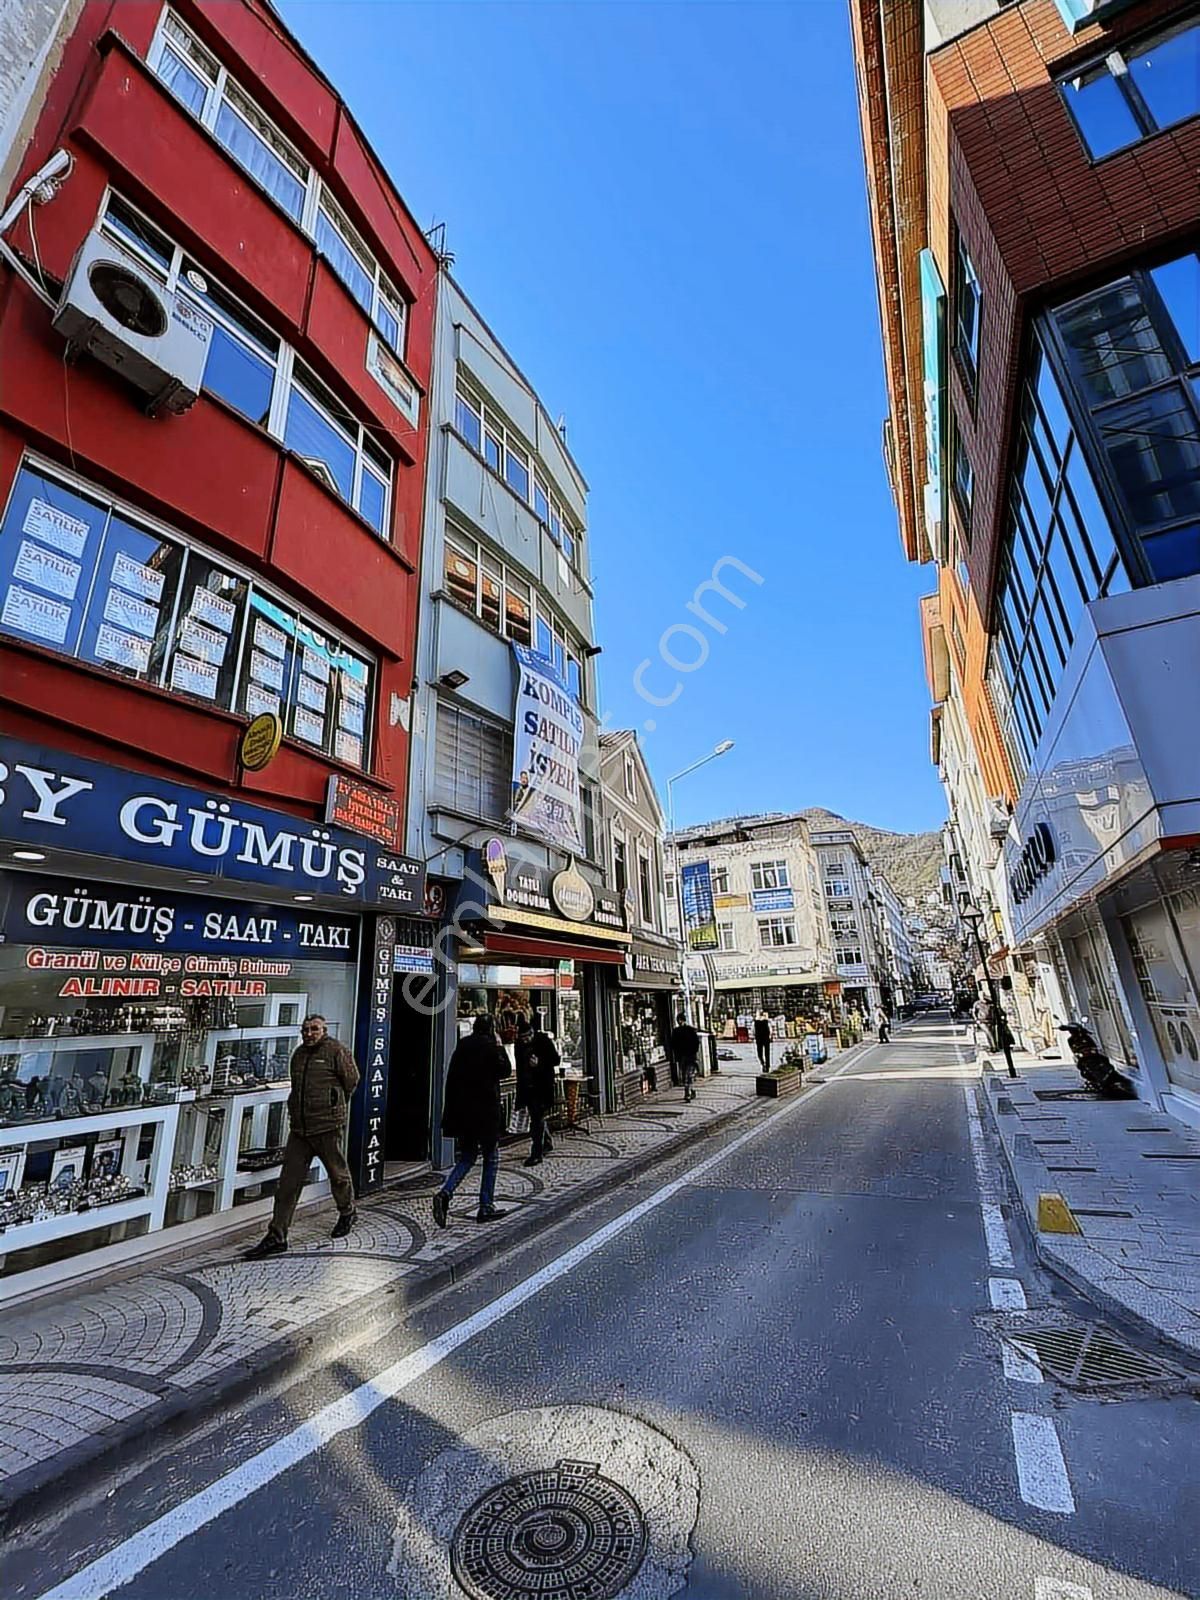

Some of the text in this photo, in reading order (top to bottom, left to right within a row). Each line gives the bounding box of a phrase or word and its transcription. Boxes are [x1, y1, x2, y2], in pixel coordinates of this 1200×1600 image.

[33, 505, 84, 537] SATILIK
[23, 548, 76, 578] SATILIK
[10, 593, 66, 620] SATILIK
[0, 761, 367, 895] Y GÜMÜŞ
[376, 857, 419, 875] SAAT
[391, 874, 404, 886] &
[380, 886, 413, 901] TAKI
[518, 875, 540, 892] TATLI
[26, 888, 175, 943] GÜMÜŞ
[202, 912, 277, 943] SAAT
[299, 922, 352, 949] TAKI
[26, 946, 292, 979] Granül ve Külçe Gümüş Bulunur
[58, 976, 161, 997] ALINIR
[179, 979, 267, 997] SATILIR
[375, 948, 390, 1023] GÜMÜŞ
[371, 1037, 385, 1098] SAAT
[367, 1117, 381, 1183] TAKI
